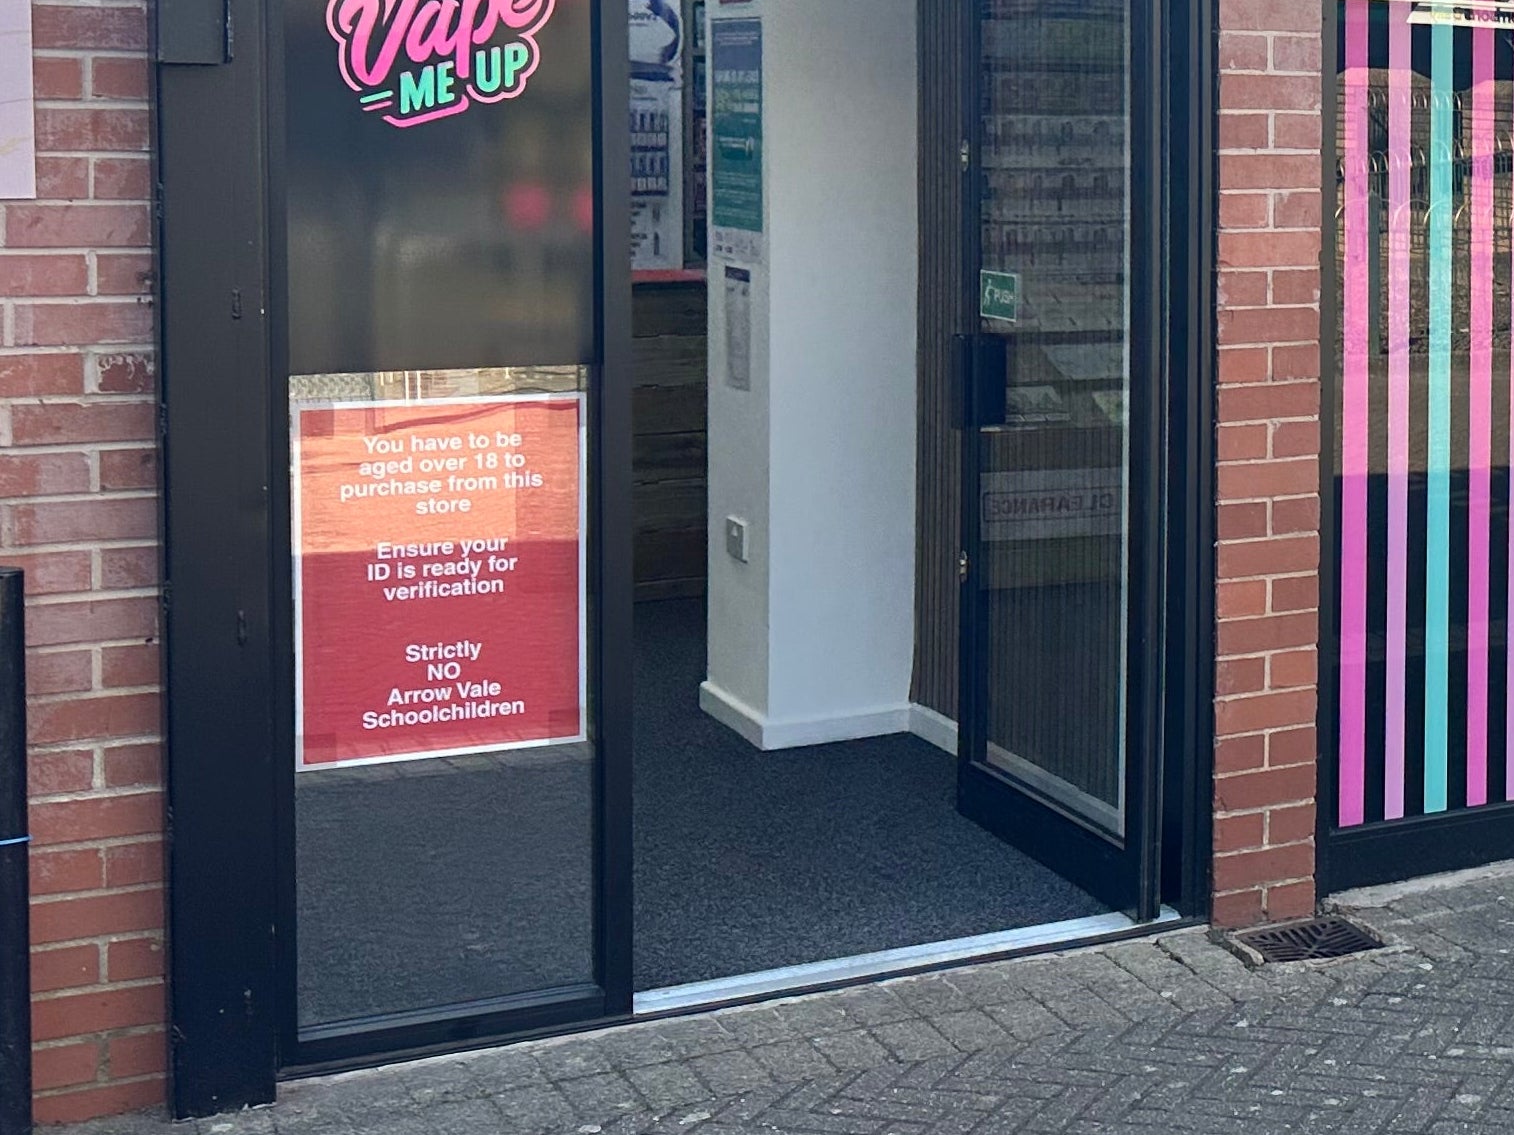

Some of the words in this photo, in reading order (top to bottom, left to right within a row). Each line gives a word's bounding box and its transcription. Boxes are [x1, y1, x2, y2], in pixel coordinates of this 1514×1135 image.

[400, 61, 455, 114] ME
[476, 42, 528, 93] UP
[364, 436, 403, 454] You
[411, 435, 462, 451] have
[468, 433, 489, 448] to
[496, 431, 522, 447] be
[359, 456, 413, 480] aged
[419, 455, 467, 472] over
[474, 453, 497, 470] 18
[504, 452, 526, 468] to
[340, 477, 442, 502] purchase
[447, 474, 497, 492] from
[503, 471, 543, 488] this
[415, 498, 472, 515] store
[376, 540, 454, 560] Ensure
[460, 536, 508, 558] your
[367, 564, 390, 582] ID
[397, 562, 416, 580] is
[422, 559, 482, 580] ready
[488, 555, 517, 572] for
[383, 577, 504, 601] verification
[405, 640, 482, 662] Strictly
[427, 661, 461, 681] NO
[387, 685, 452, 706] Arrow
[456, 679, 502, 698] Vale
[362, 699, 525, 730] Schoolchildren
